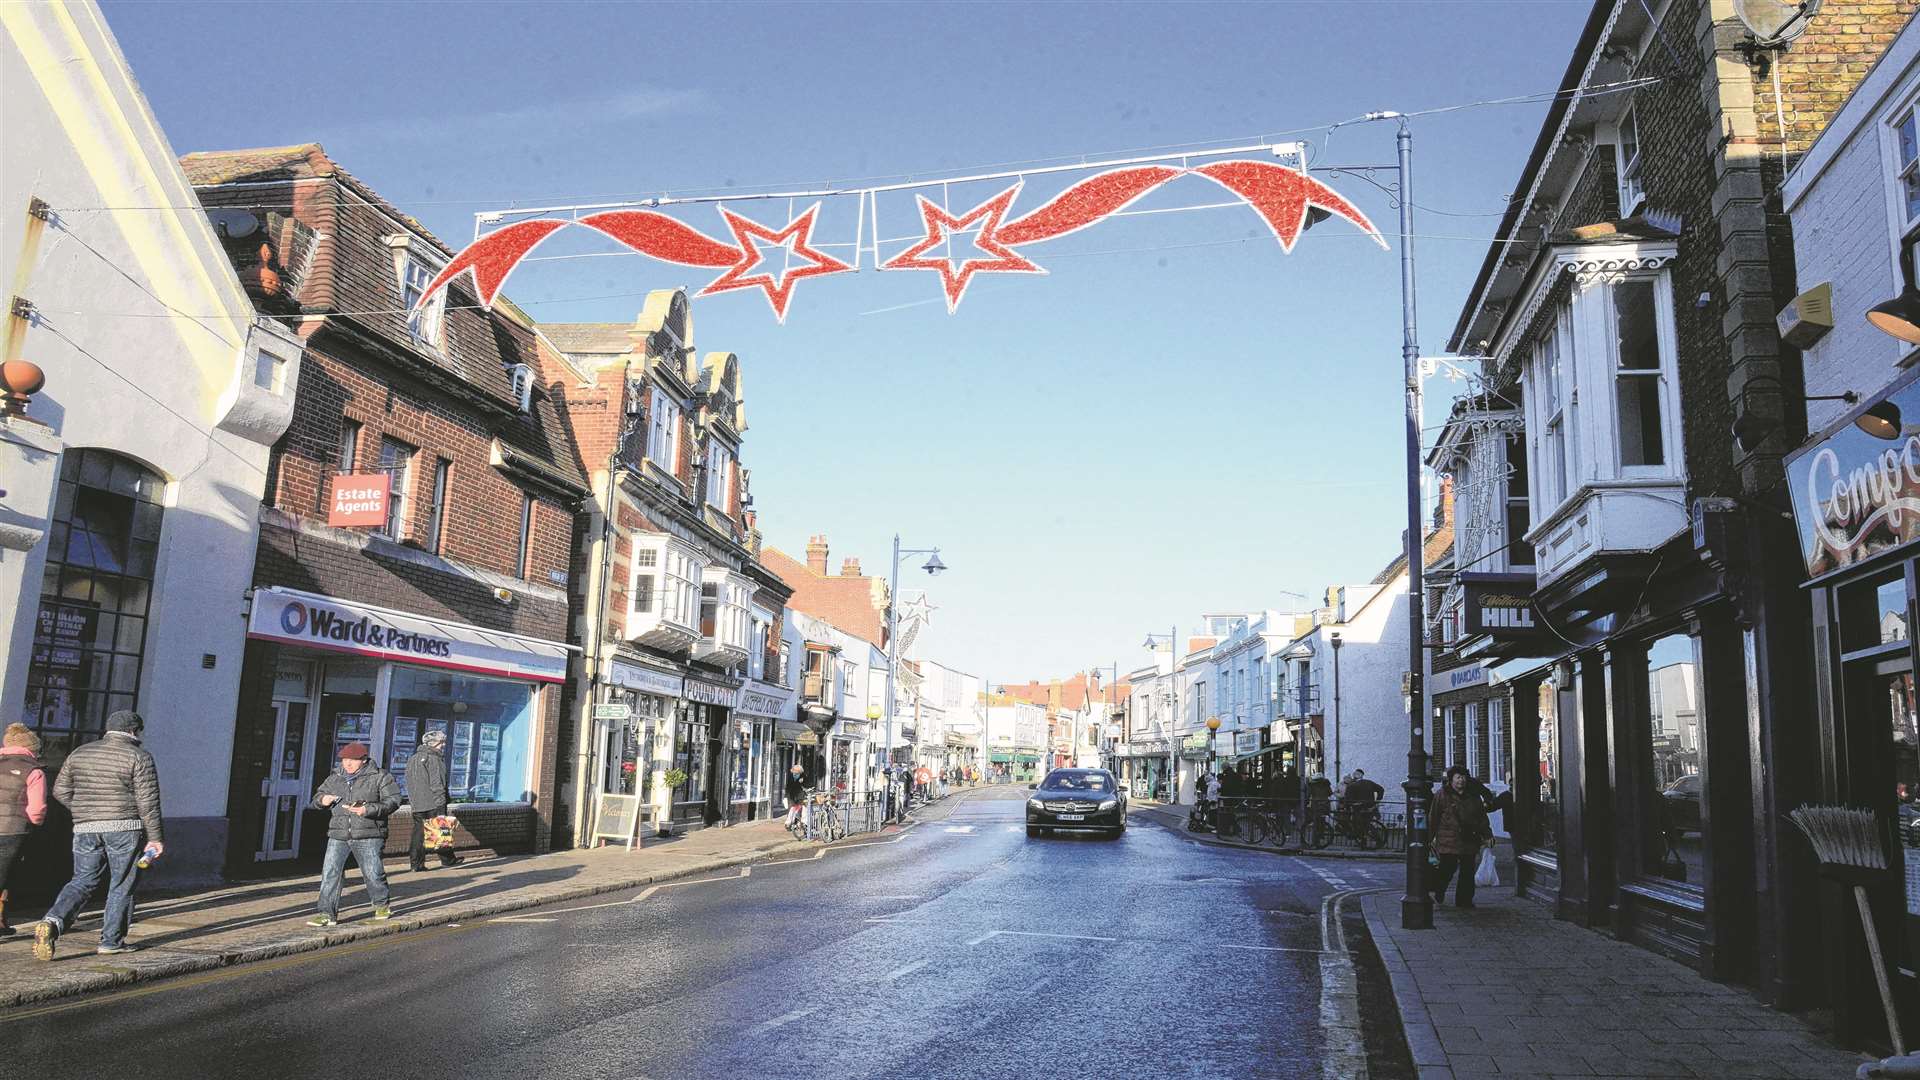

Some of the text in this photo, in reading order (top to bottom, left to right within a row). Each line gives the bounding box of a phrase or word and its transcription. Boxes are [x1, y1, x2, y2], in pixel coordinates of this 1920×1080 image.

[336, 489, 382, 500] Estate
[335, 500, 382, 515] Agents
[1479, 593, 1532, 607] William
[1481, 607, 1535, 627] HILL
[309, 607, 451, 657] Ward & Partners
[1456, 667, 1481, 685] BARCLAYS
[687, 682, 735, 707] POUND CITY
